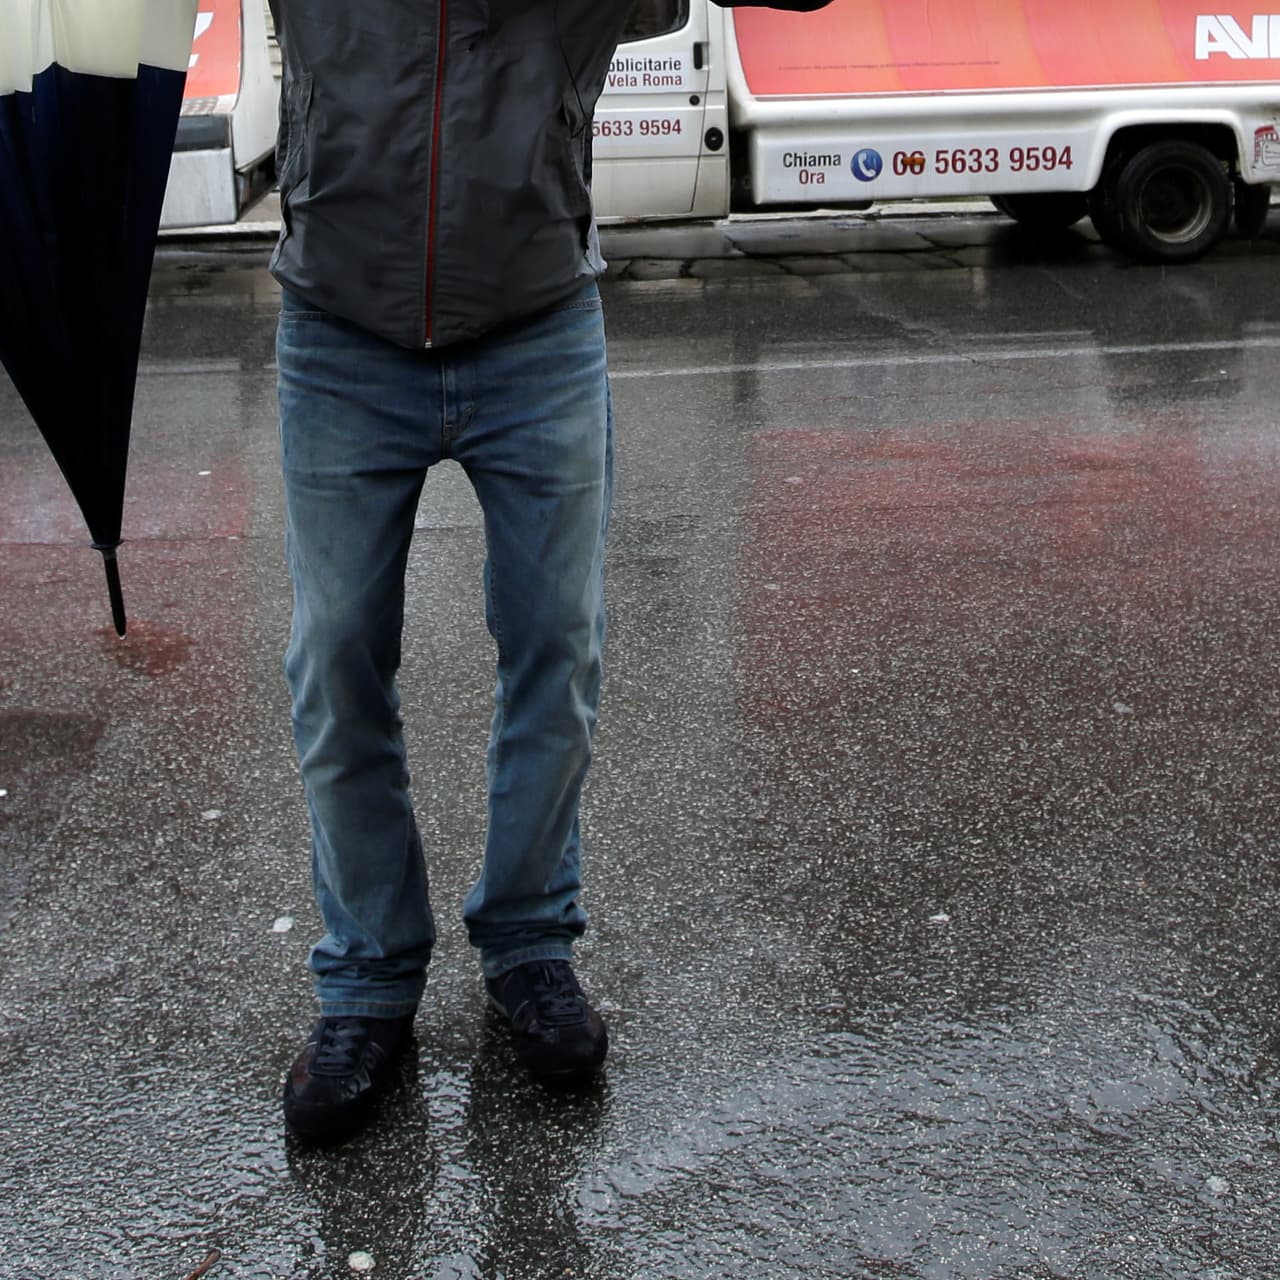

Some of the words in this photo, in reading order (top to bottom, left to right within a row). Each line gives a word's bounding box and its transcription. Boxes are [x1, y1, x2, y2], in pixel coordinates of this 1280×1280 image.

[607, 73, 638, 87] Vela
[643, 72, 682, 87] Roma
[592, 120, 633, 137] 5633
[639, 119, 682, 137] 9594
[782, 151, 841, 168] Chiama
[934, 148, 1000, 174] 5633
[1009, 145, 1073, 172] 9594
[799, 169, 825, 185] Ora
